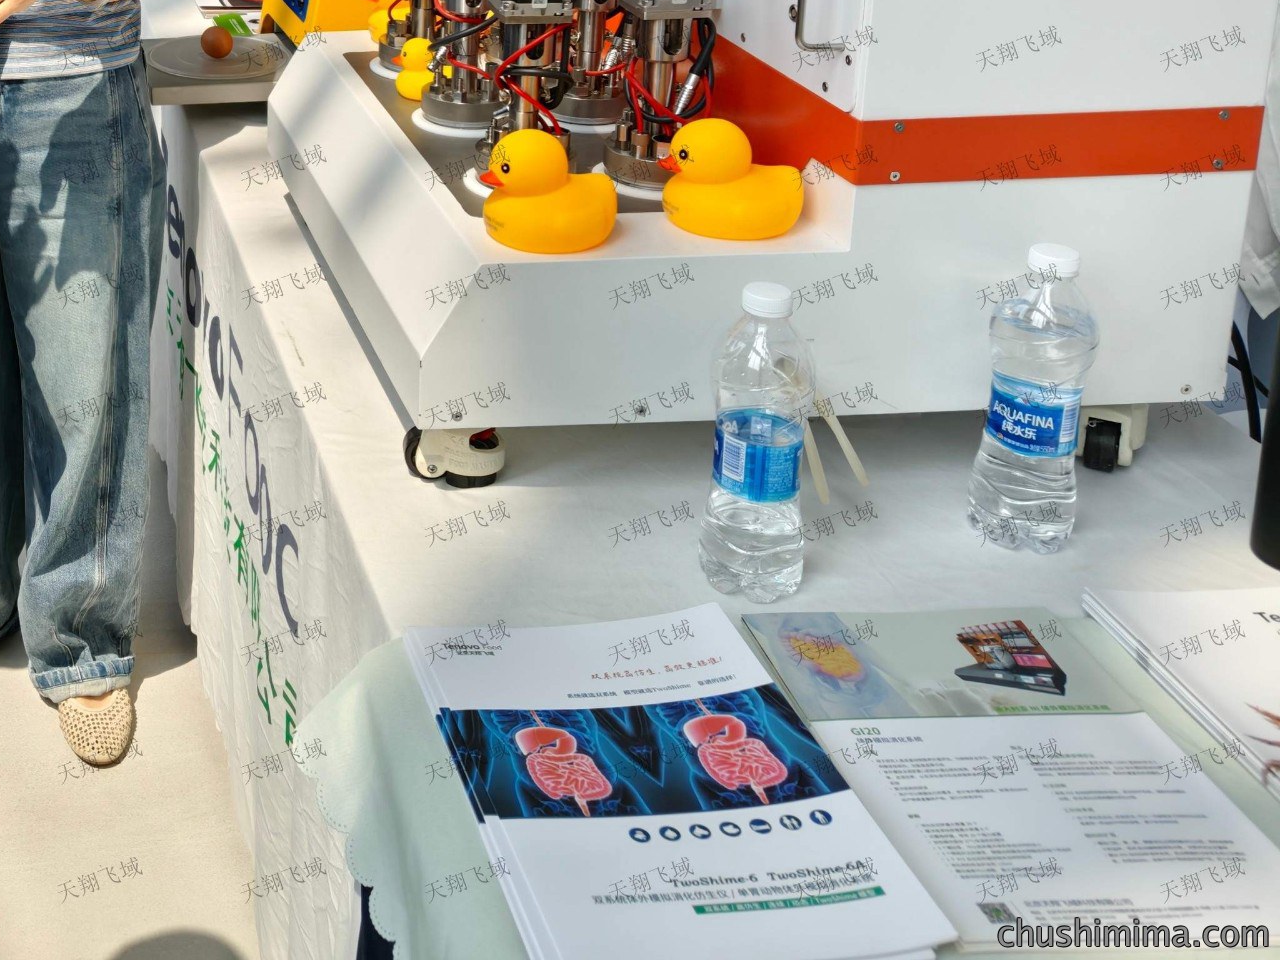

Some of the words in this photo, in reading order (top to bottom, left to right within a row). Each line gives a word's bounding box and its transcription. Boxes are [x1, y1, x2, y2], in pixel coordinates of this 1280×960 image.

[993, 400, 1055, 430] AQUAFINA
[1001, 419, 1038, 441] 纯水乐
[850, 727, 881, 736] GI20
[671, 873, 758, 888] TwoShime-6
